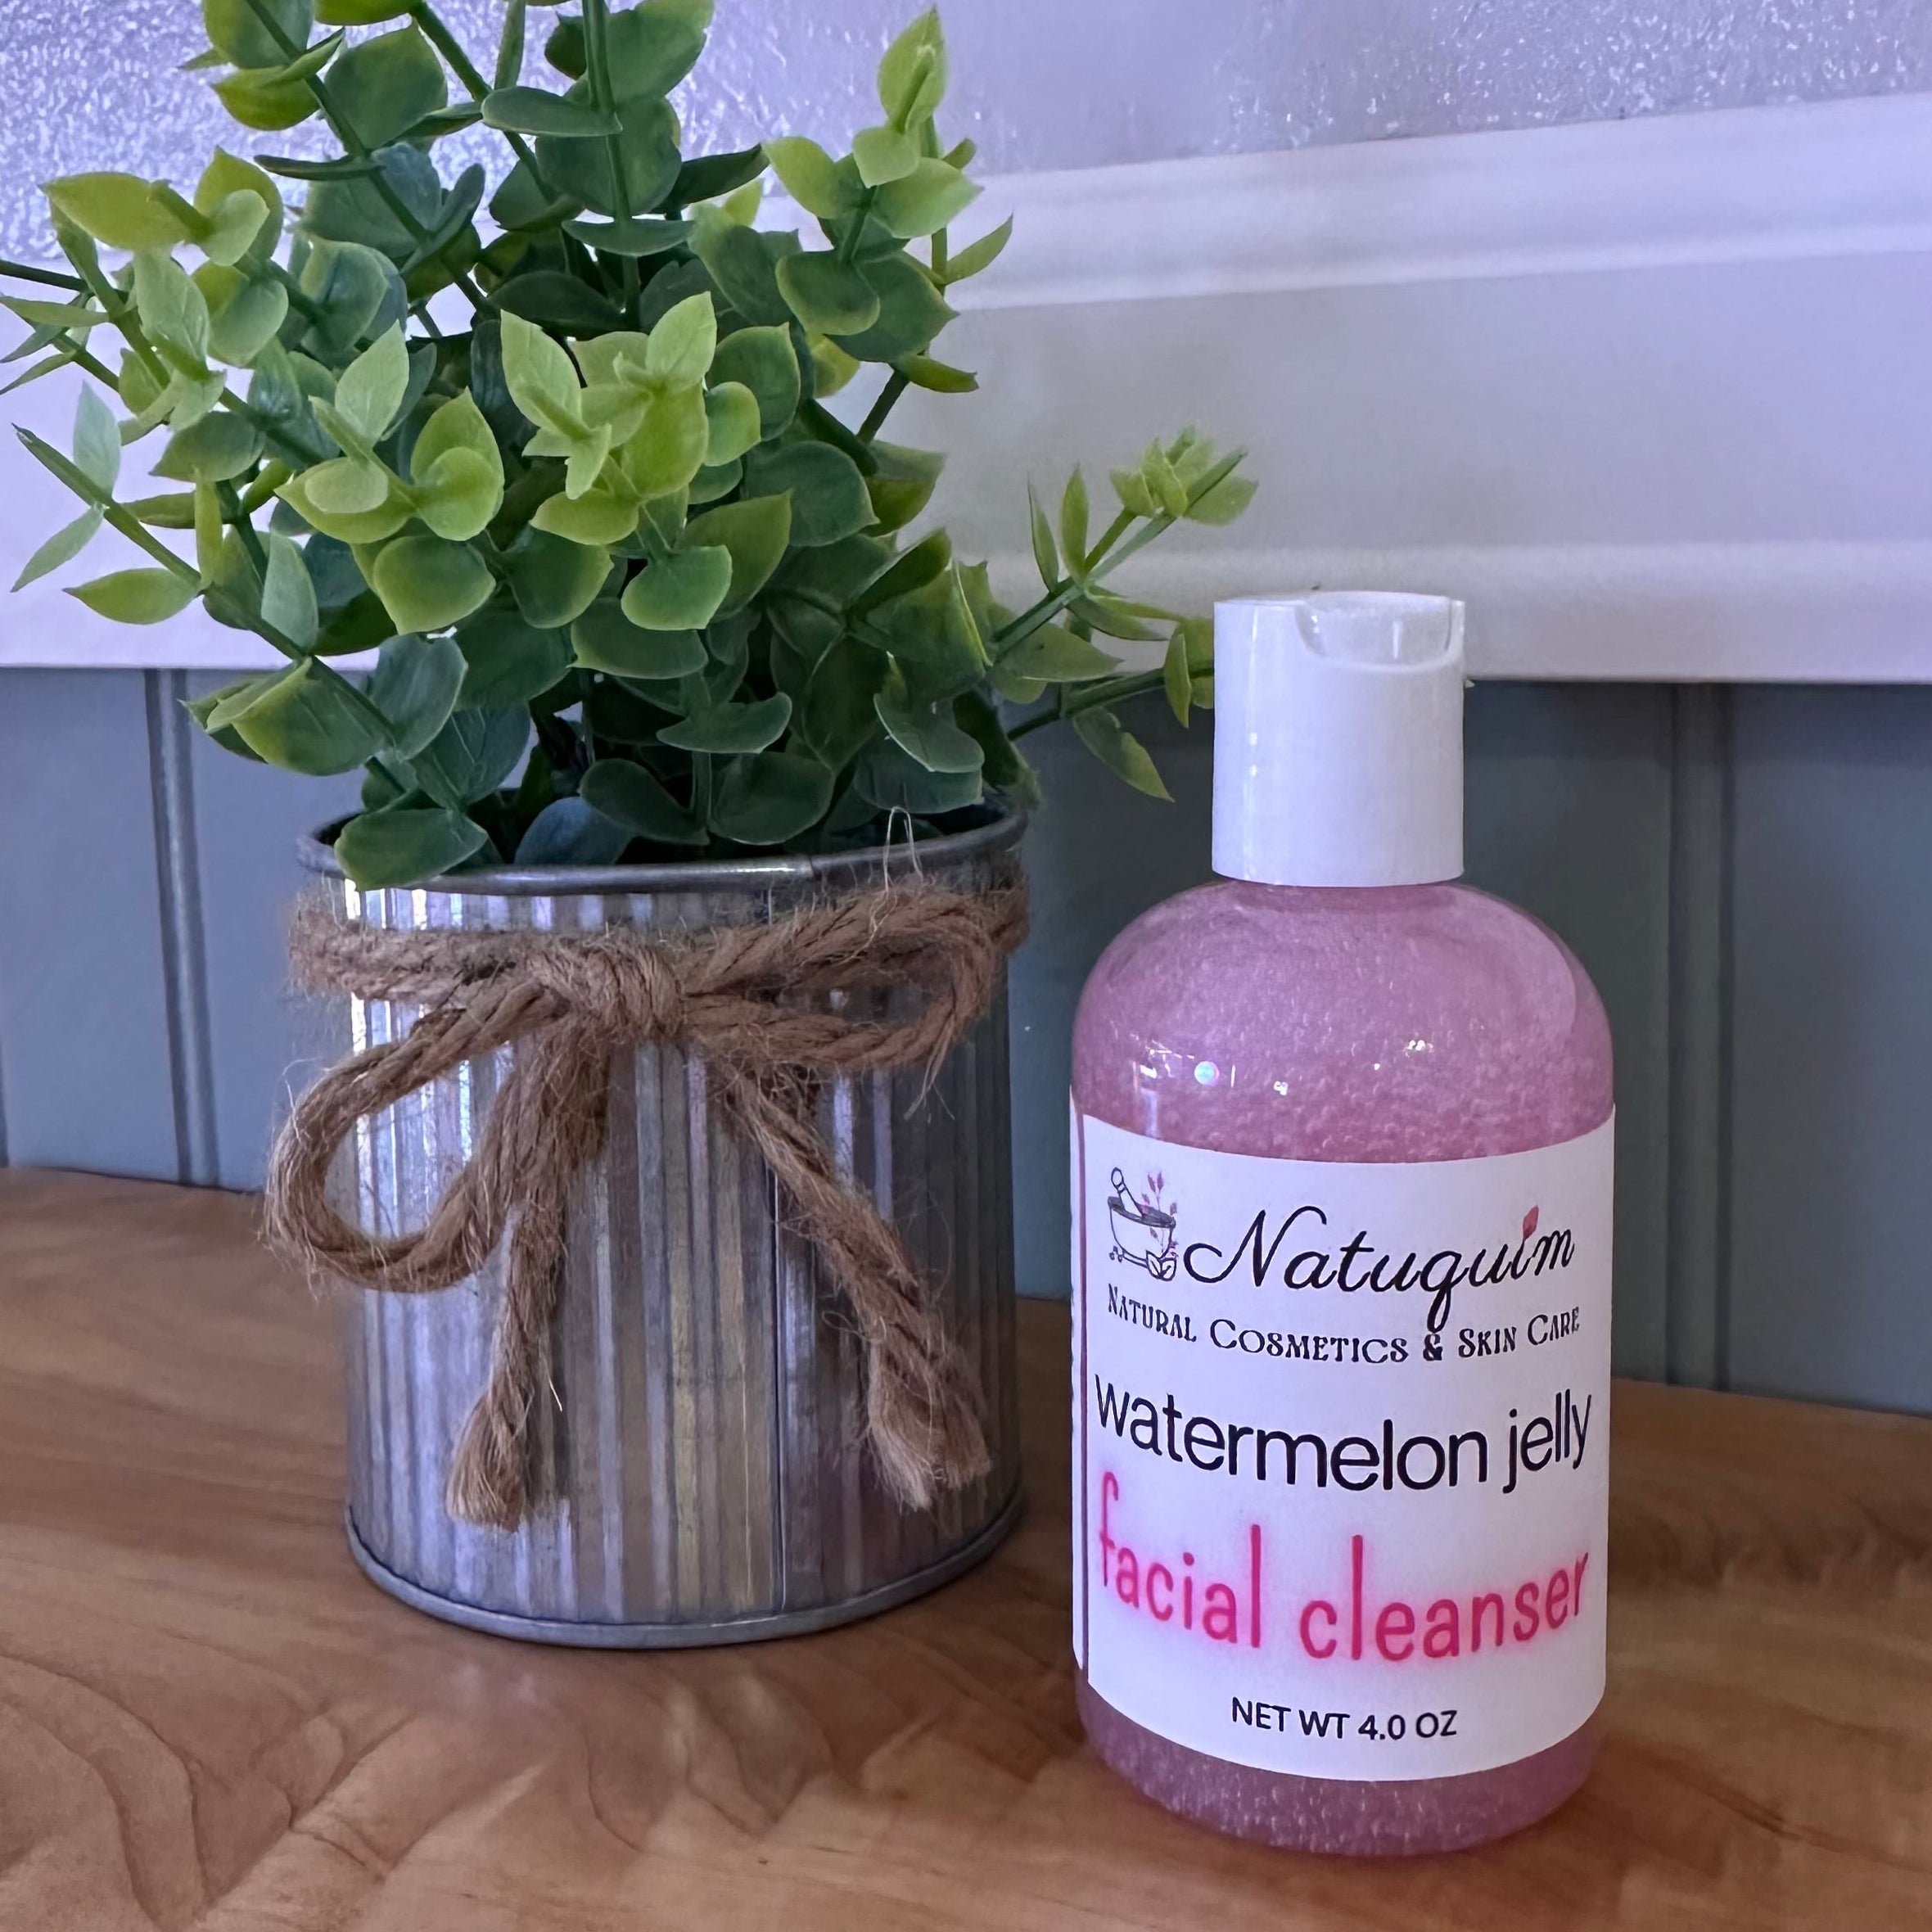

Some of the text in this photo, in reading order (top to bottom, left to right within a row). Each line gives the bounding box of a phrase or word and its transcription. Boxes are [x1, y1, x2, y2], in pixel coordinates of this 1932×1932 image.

[1182, 1204, 1577, 1330] Natuquim
[1423, 1332, 1444, 1362] &
[1094, 1373, 1593, 1495] watermelon jelly
[1097, 1470, 1591, 1663] facial cleanser
[1230, 1696, 1458, 1741] NET WT 4.0 OZ
